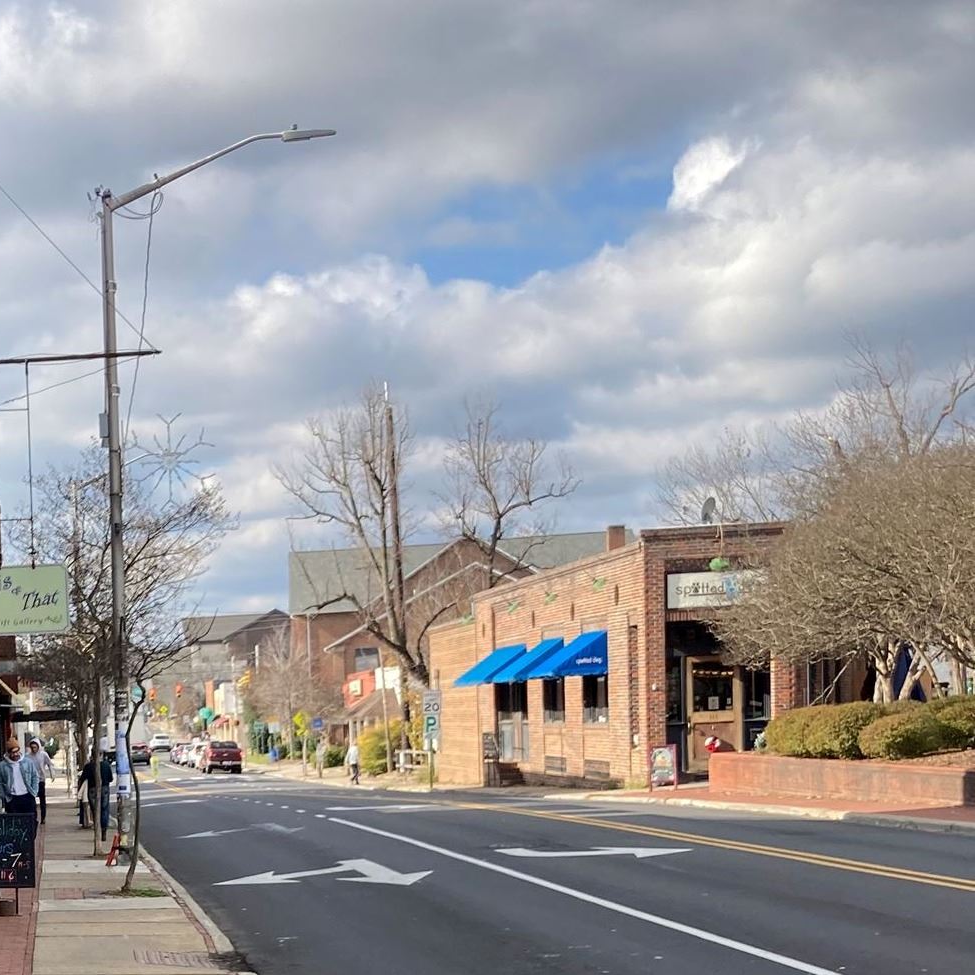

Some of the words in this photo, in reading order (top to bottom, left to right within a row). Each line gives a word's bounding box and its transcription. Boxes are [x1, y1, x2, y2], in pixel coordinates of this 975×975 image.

[22, 590, 59, 612] That
[424, 702, 440, 712] 20
[426, 716, 437, 732] P
